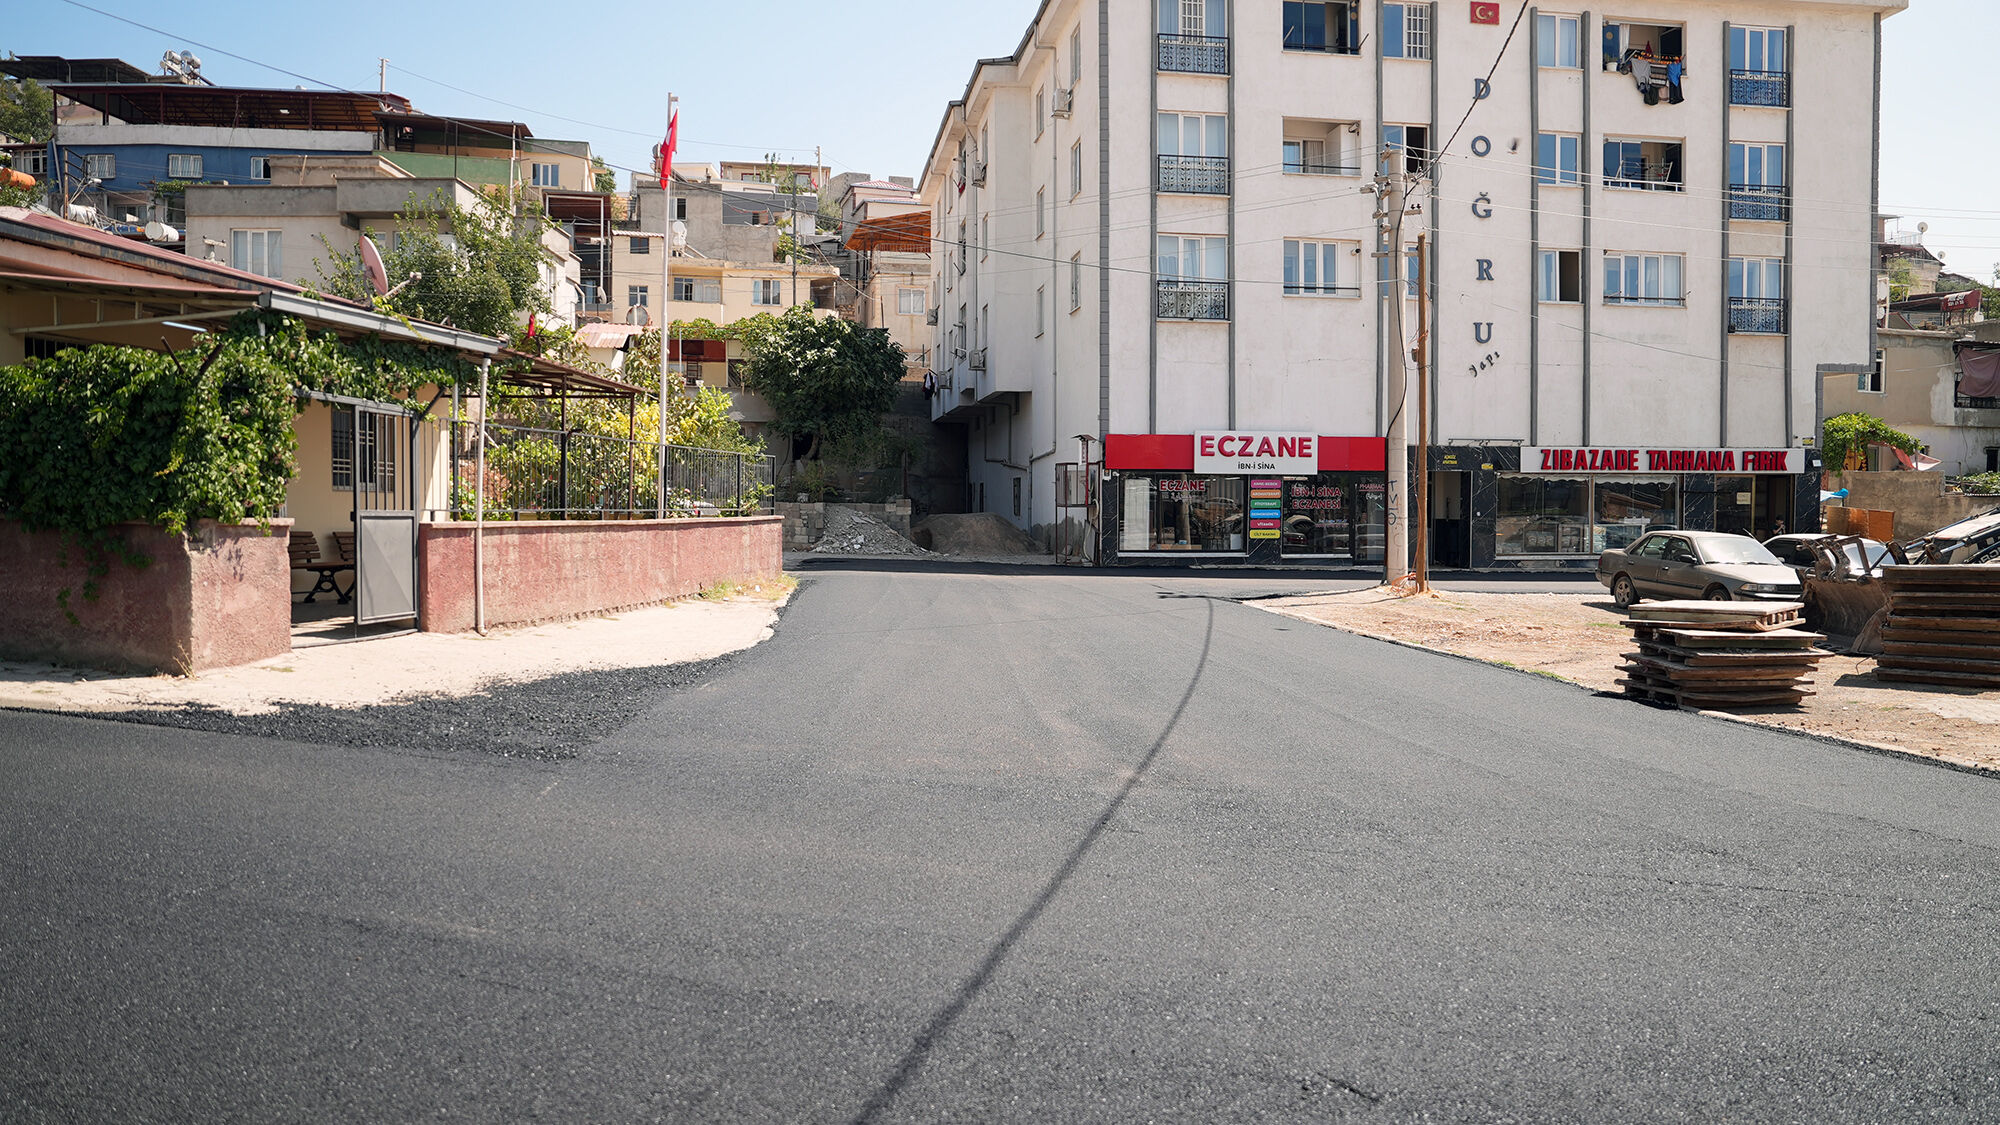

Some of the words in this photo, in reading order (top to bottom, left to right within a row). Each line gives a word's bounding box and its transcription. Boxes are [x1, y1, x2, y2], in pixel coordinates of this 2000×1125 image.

[1200, 435, 1313, 458] ECZANE
[1237, 462, 1256, 470] İBN-İ
[1257, 462, 1275, 470] SİNA
[1540, 449, 1640, 471] ZIBAZADE
[1647, 450, 1736, 471] TARHANA
[1159, 479, 1205, 491] ECZANE
[1317, 484, 1342, 497] SİNA
[1292, 498, 1341, 509] ECZANESİ
